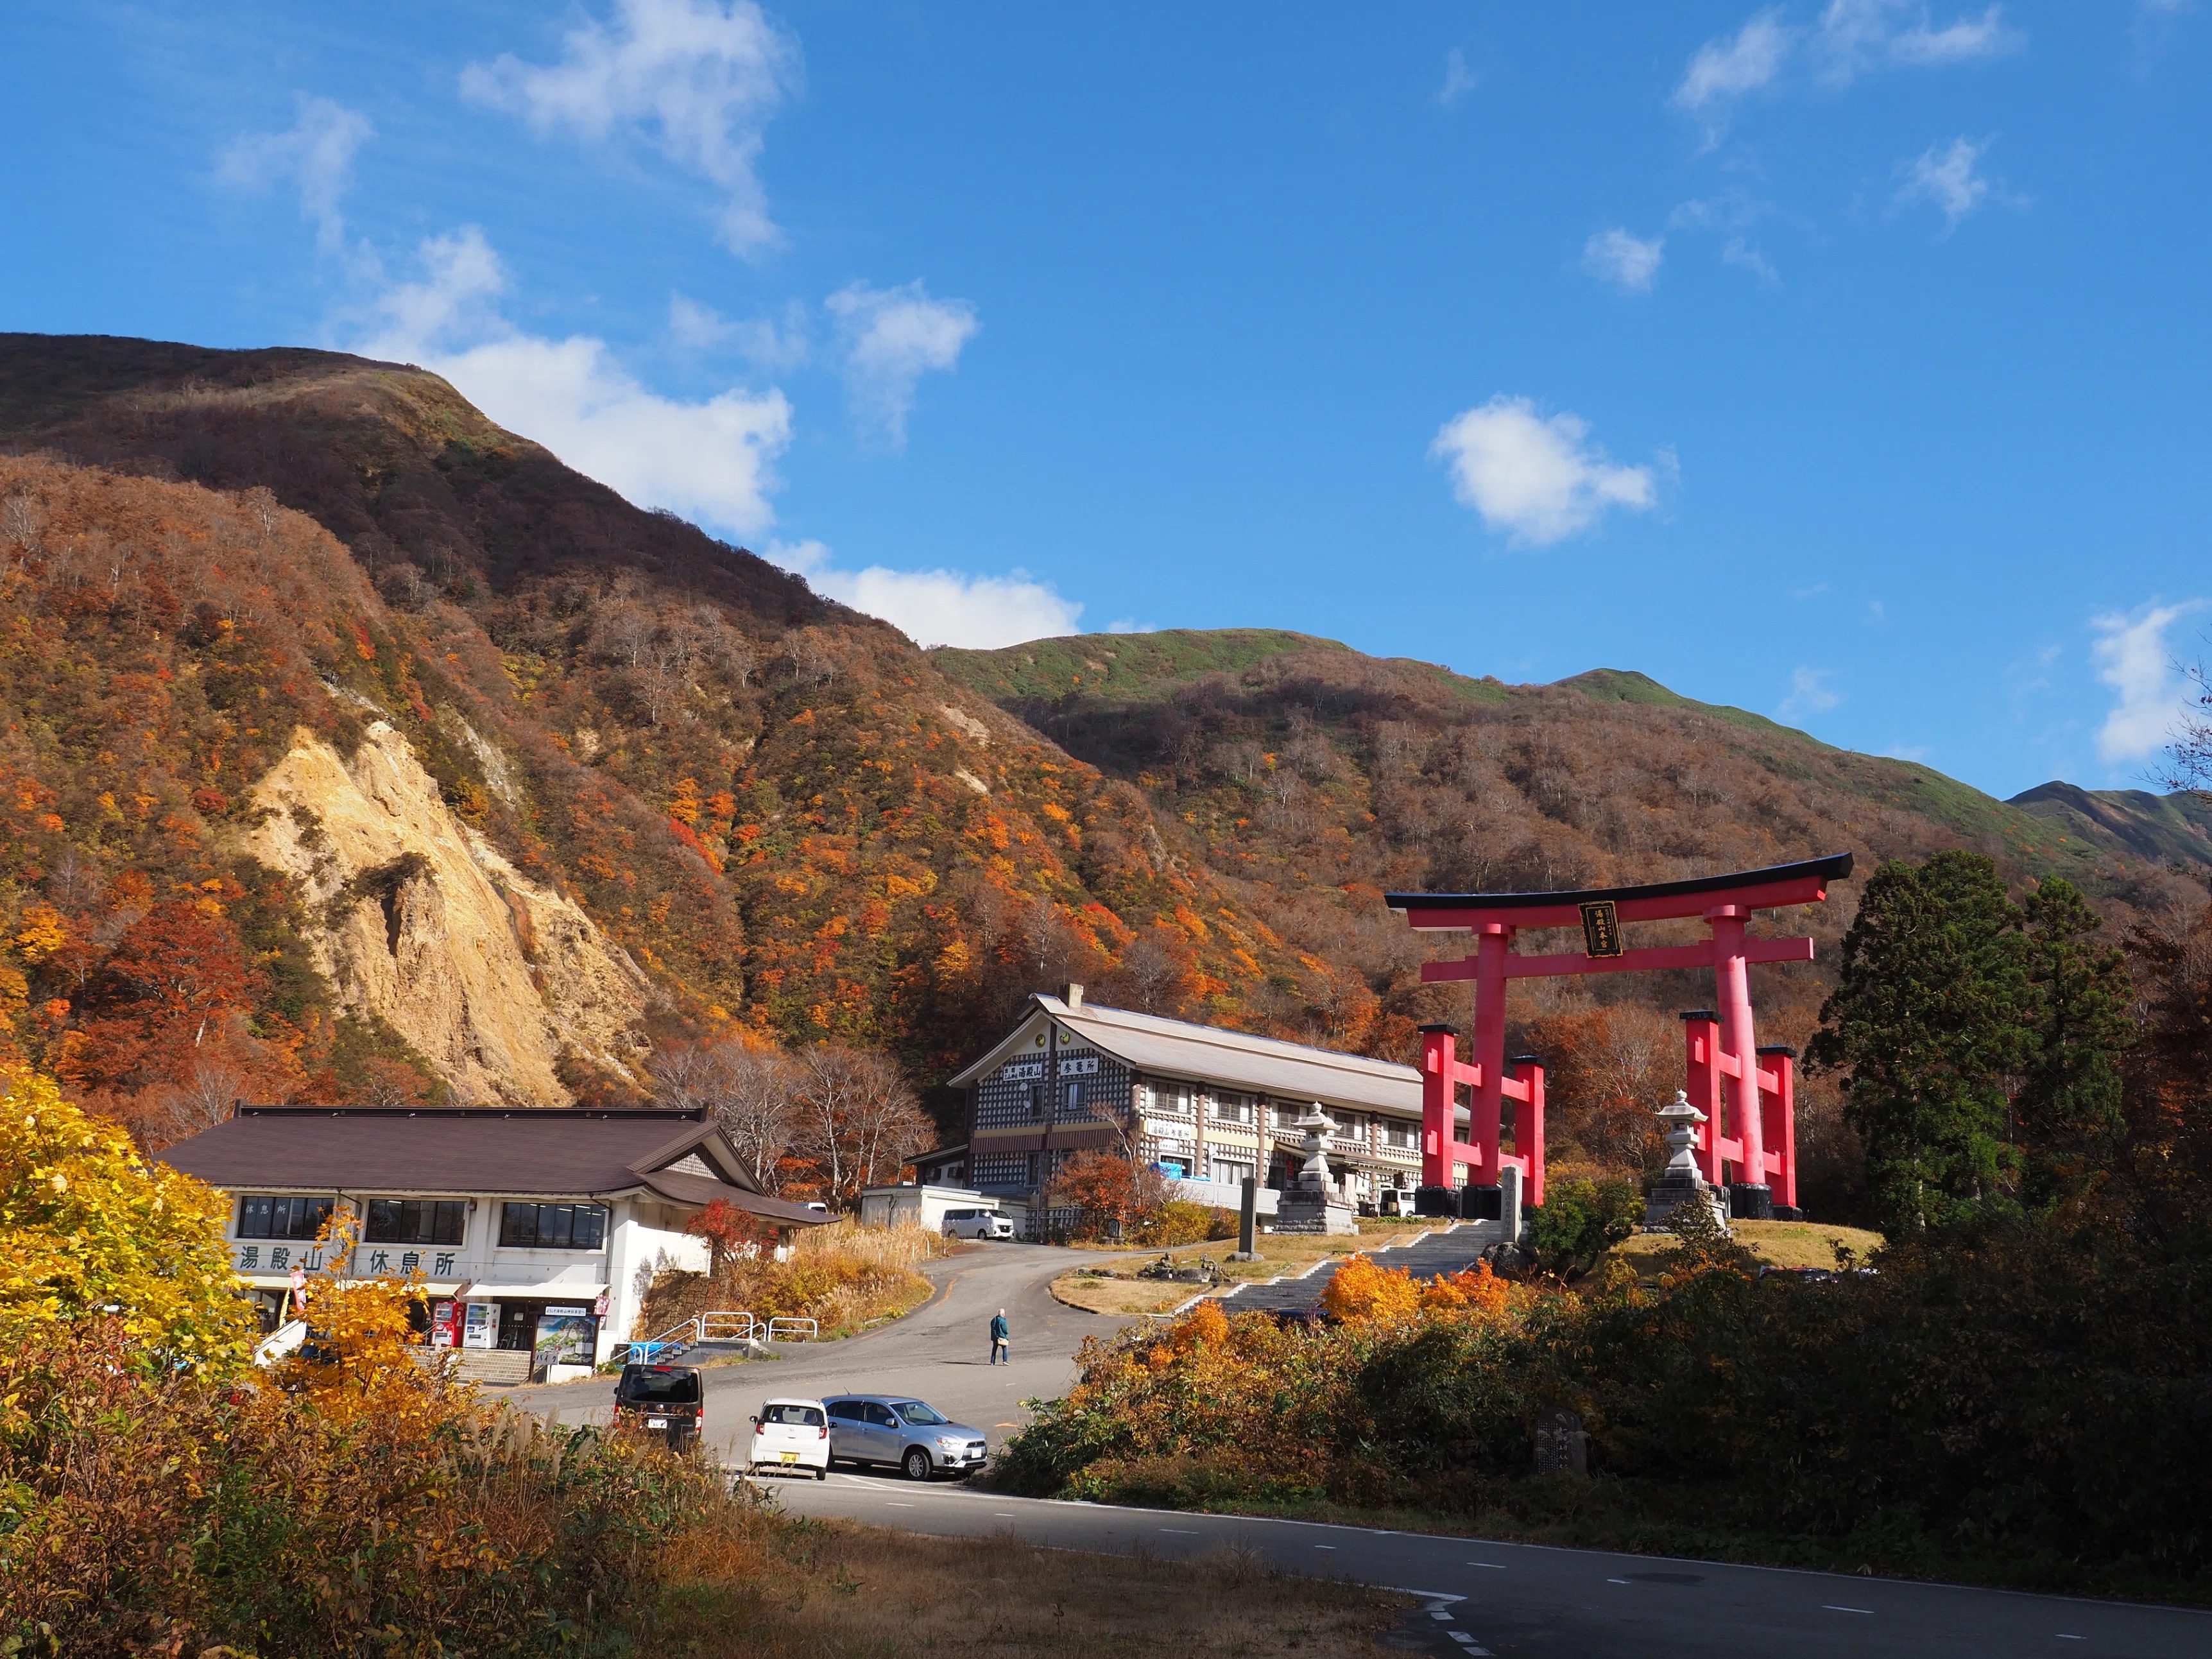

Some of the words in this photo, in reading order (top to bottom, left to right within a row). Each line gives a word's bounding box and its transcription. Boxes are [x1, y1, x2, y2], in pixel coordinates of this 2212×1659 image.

[1018, 1065, 1041, 1078] 湯殿山
[245, 1205, 287, 1215] 休息所
[240, 1245, 322, 1271] 湯殿山
[370, 1250, 456, 1276] 休息所
